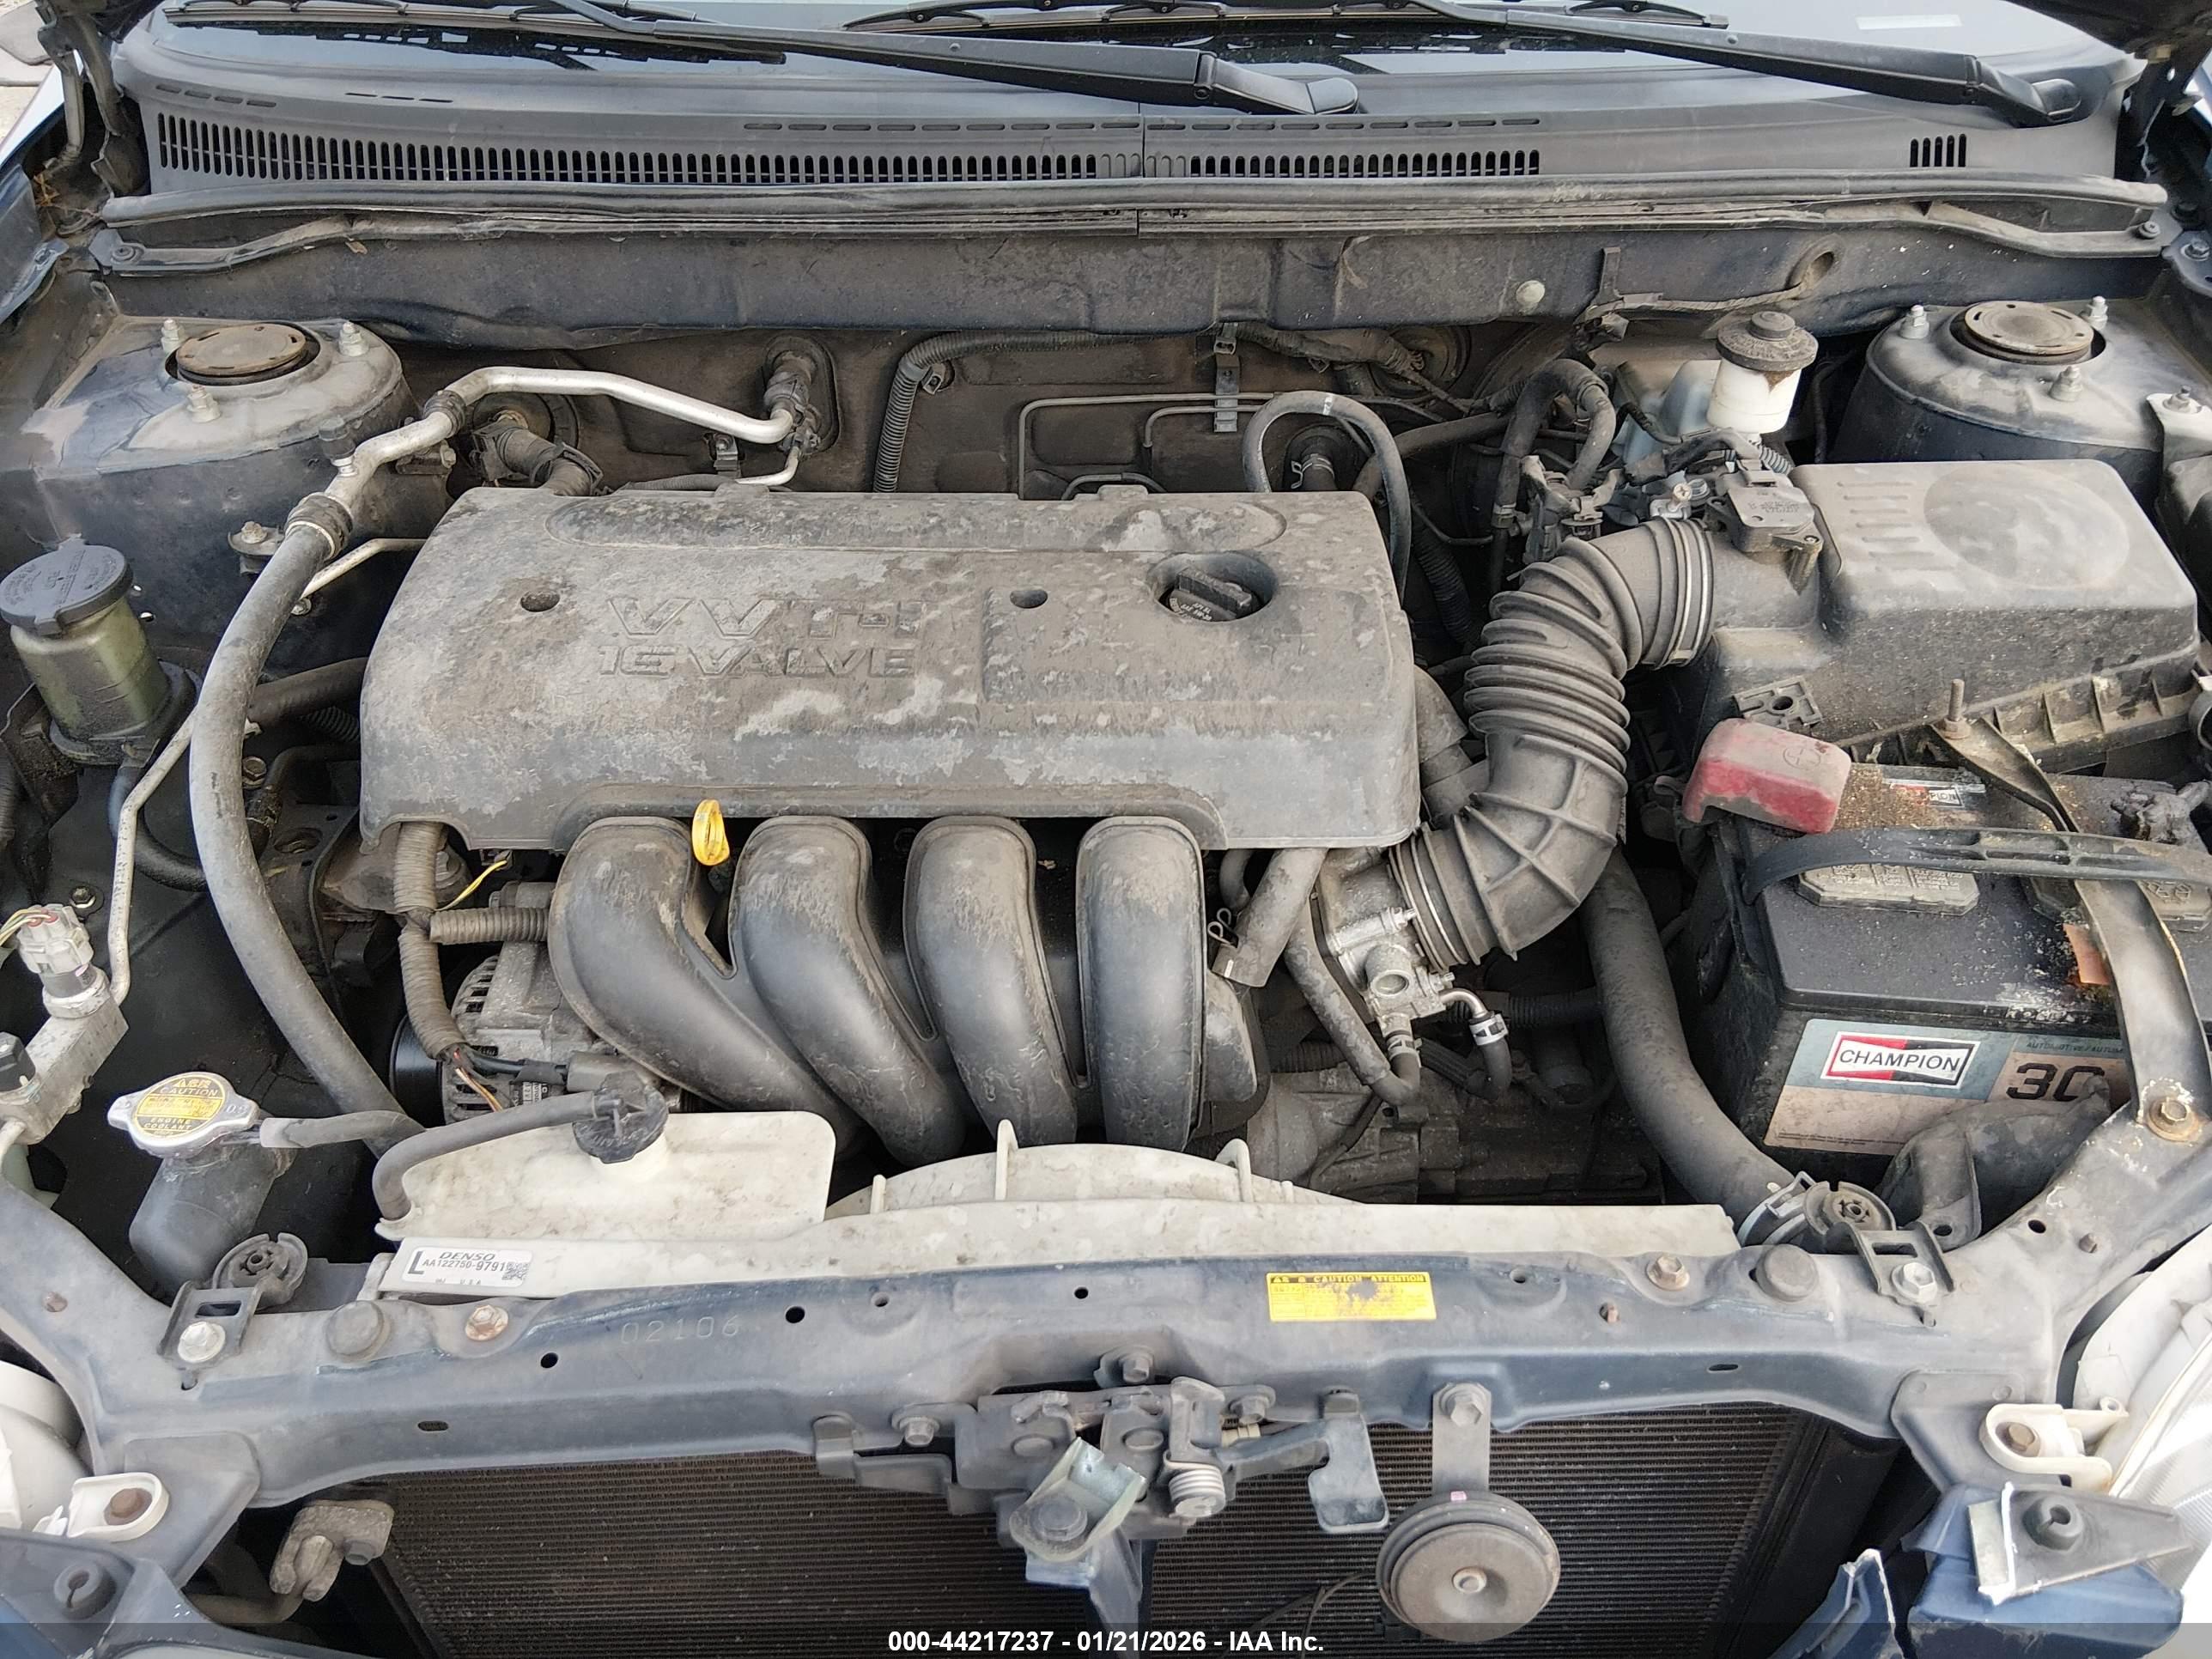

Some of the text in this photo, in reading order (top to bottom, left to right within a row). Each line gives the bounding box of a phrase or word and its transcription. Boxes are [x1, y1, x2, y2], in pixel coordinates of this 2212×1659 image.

[598, 645, 917, 678] 16 VALVE
[1838, 1048, 1960, 1073] CHAMPION
[160, 1086, 218, 1097] CAUTION
[408, 1250, 424, 1275] L
[422, 1259, 505, 1272] AA122750-9791
[439, 1251, 495, 1261] DENSO
[621, 1316, 739, 1345] 02106
